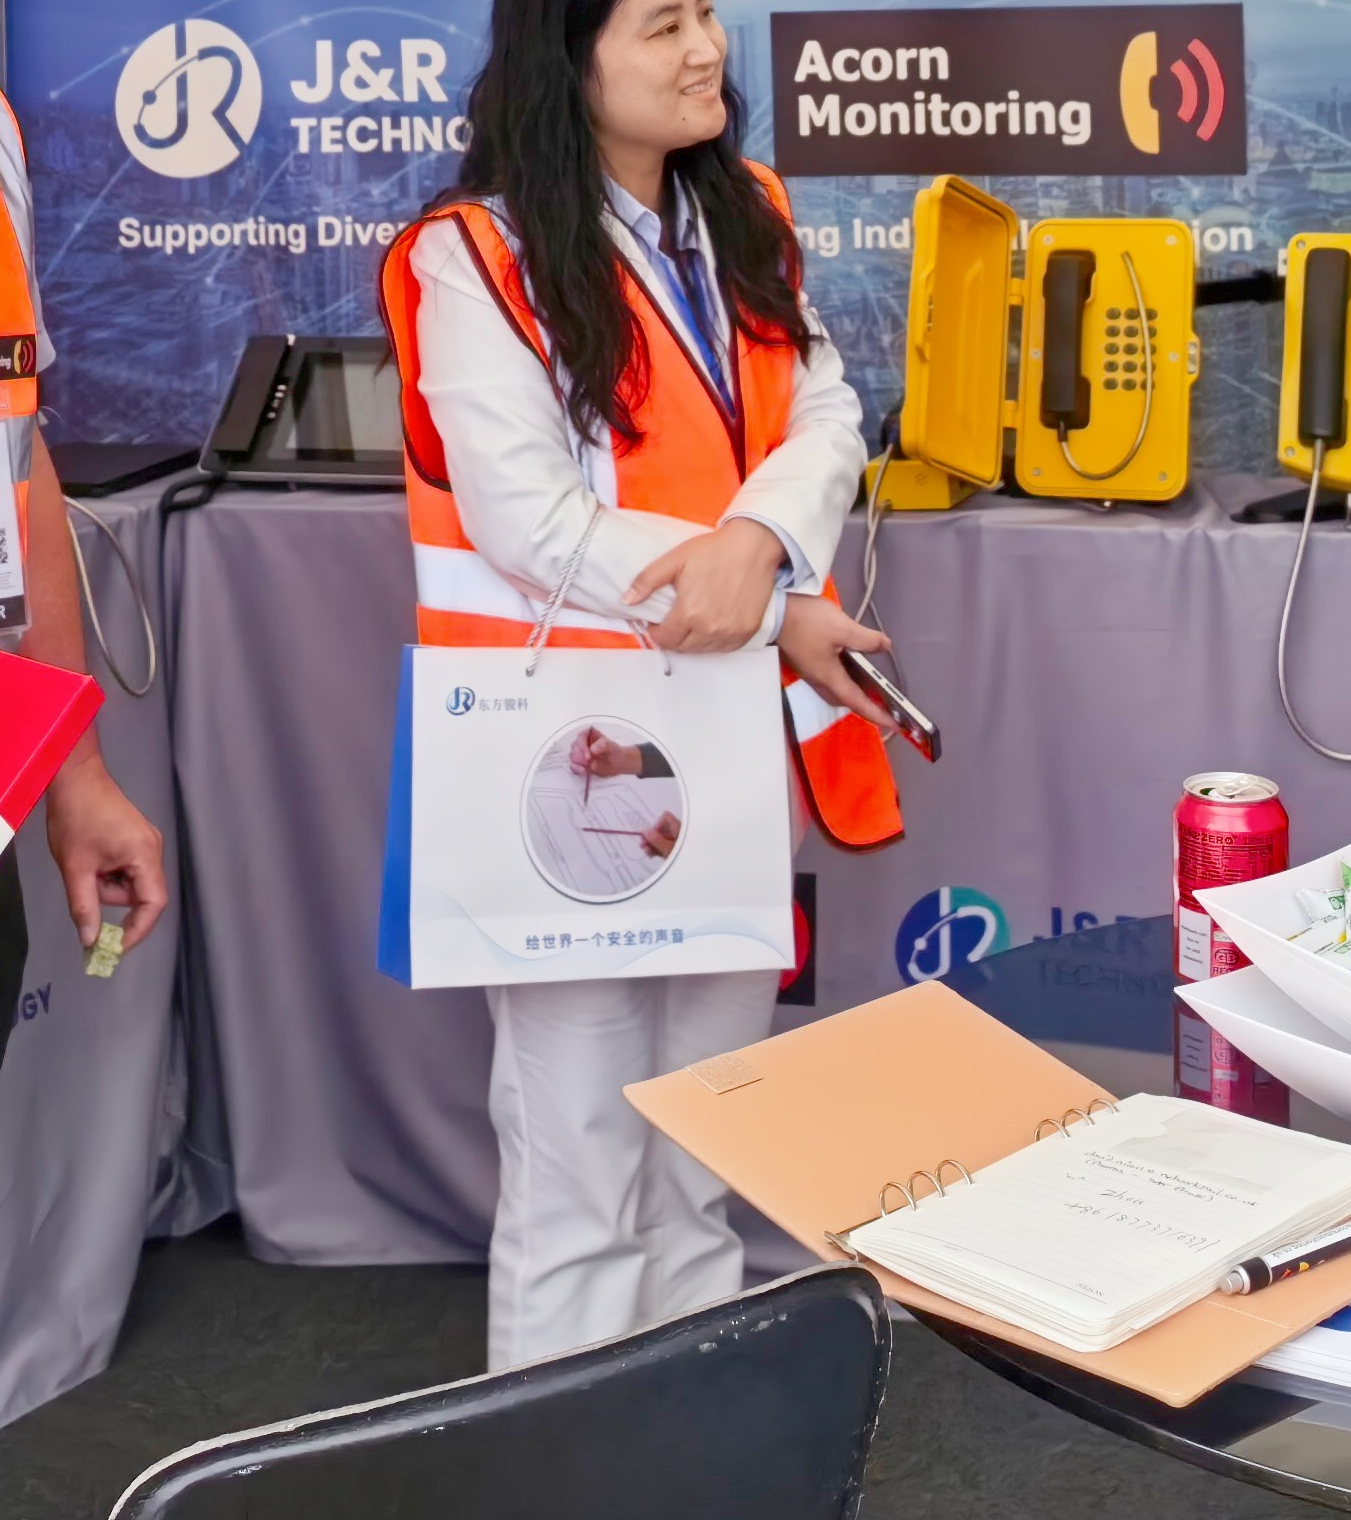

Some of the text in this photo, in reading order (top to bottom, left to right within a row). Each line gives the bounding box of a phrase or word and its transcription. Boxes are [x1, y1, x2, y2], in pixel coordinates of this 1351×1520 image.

[290, 38, 449, 104] J&R
[794, 40, 950, 84] Acorn
[797, 89, 1092, 146] Monitoring
[118, 215, 307, 255] Supporting
[525, 928, 685, 951] 给世界一个安全的声音
